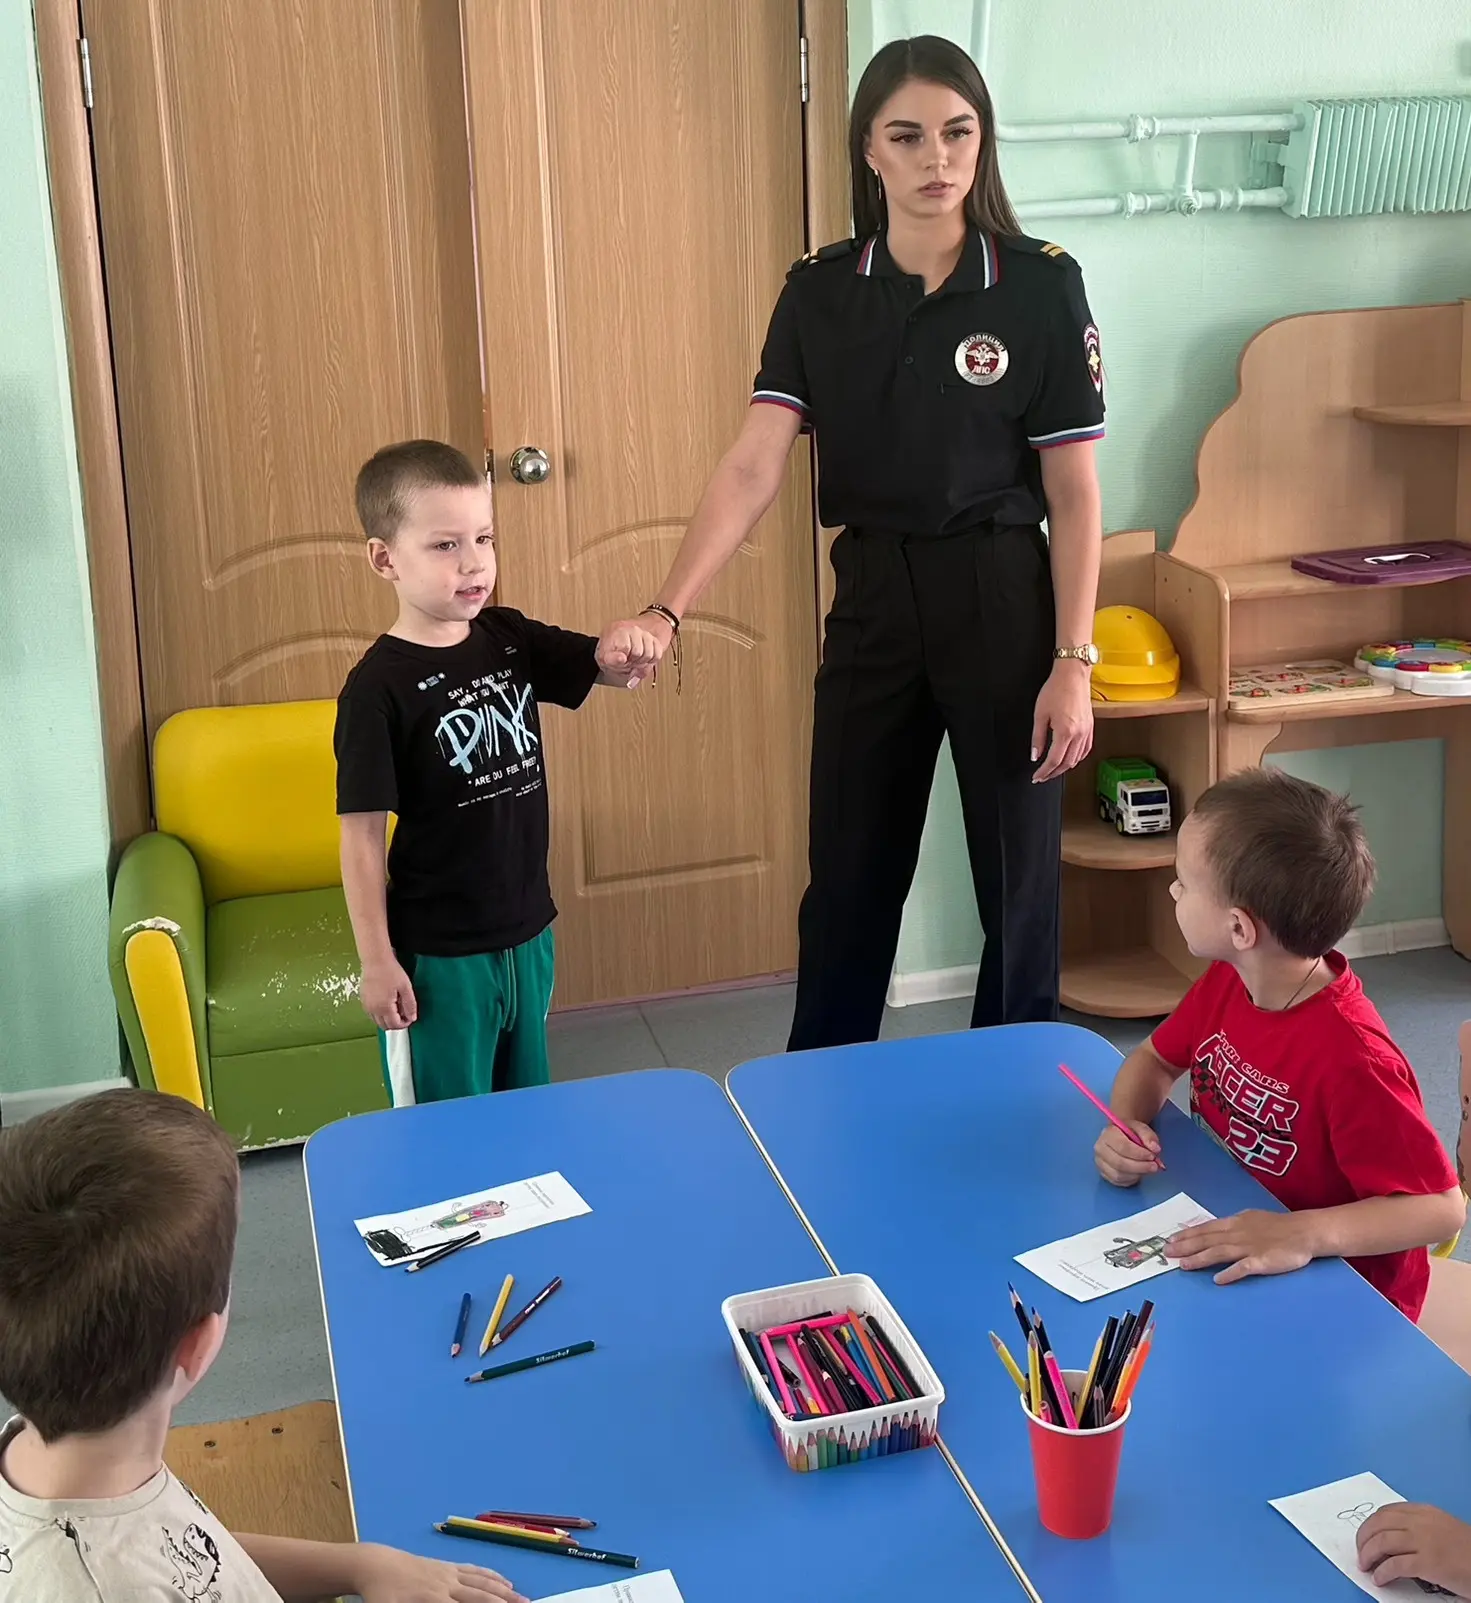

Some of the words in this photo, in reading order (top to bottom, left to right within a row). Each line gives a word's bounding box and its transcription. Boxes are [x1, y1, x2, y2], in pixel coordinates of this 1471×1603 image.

[474, 774, 492, 787] ARE
[1241, 1062, 1290, 1094] CARS
[1224, 1116, 1298, 1176] 23
